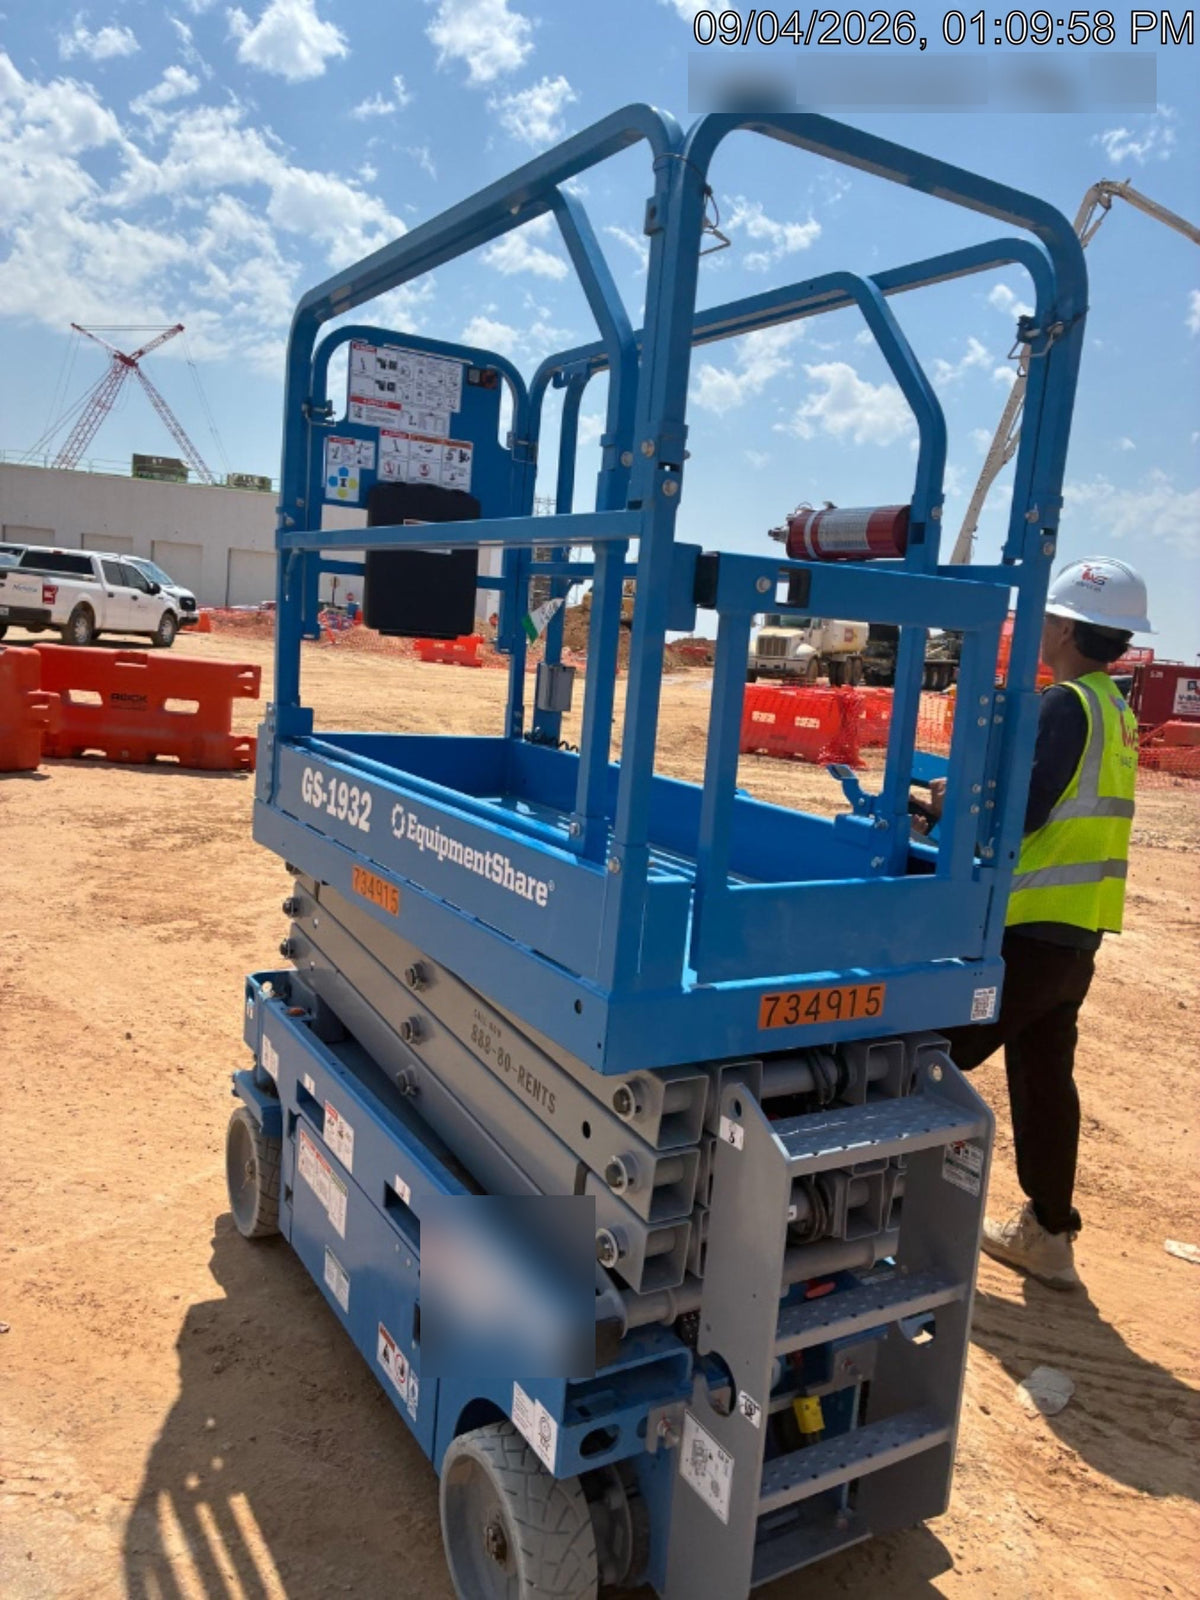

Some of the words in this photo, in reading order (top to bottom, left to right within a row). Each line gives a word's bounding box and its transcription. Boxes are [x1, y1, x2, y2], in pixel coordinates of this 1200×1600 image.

[301, 767, 372, 833] GS-1932
[353, 866, 399, 915] 734915
[764, 986, 881, 1028] 734915
[470, 1023, 557, 1114] 888-80-RENTS
